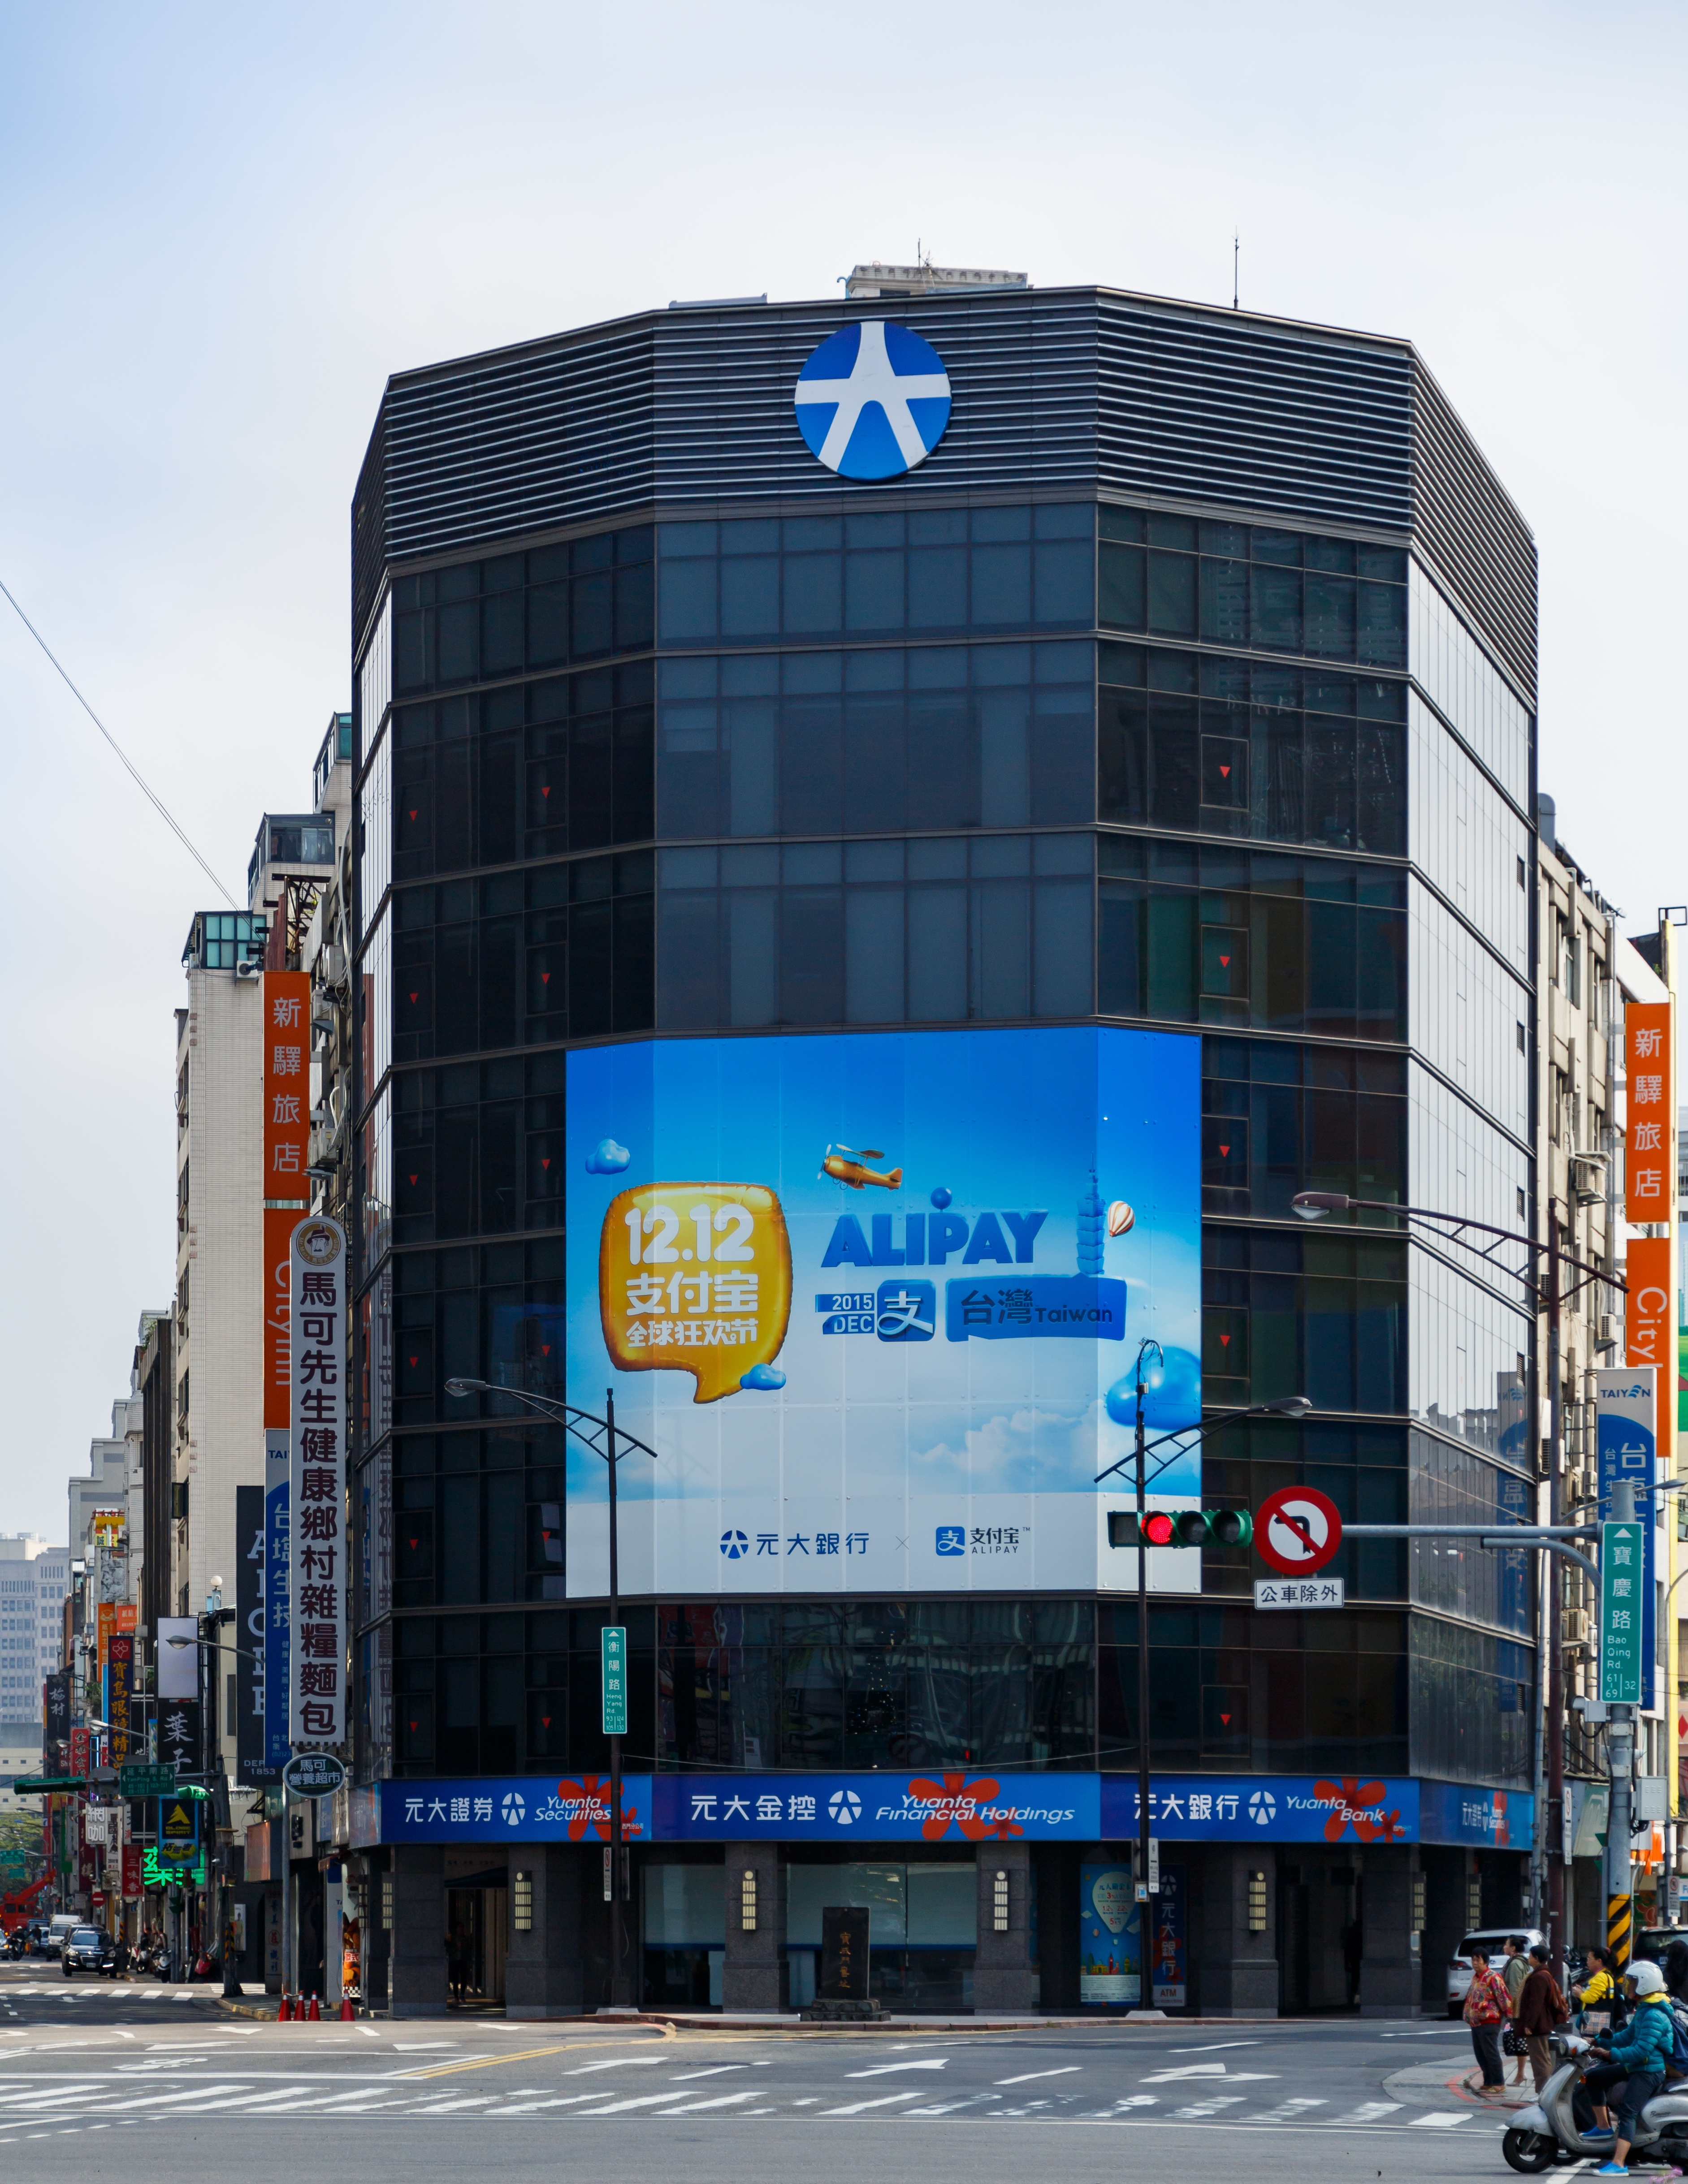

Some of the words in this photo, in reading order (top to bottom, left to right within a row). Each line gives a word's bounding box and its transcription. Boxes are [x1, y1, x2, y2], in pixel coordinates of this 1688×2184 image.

[273, 997, 301, 1172] 新驛旅店
[1635, 1029, 1662, 1197] 新驛旅店
[625, 1204, 755, 1265] 12.12
[821, 1209, 1049, 1268] ALIPAY
[626, 1269, 758, 1316] 支付宝
[832, 1295, 873, 1311] 2015
[961, 1289, 1032, 1326] 台灣
[1035, 1305, 1112, 1325] Taiwan
[626, 1320, 758, 1347] 全球狂欢节
[833, 1317, 872, 1334] DEC
[299, 1272, 338, 1736] 馬可先生健康鄉村雜糧麵包
[756, 1532, 870, 1556] 元大銀行
[970, 1527, 1019, 1545] 支付宝
[1261, 1584, 1338, 1603] 公車除外
[1612, 1546, 1632, 1629] 寶慶路
[1607, 1636, 1627, 1644] Bao
[1607, 1648, 1631, 1659] Qing
[608, 1641, 619, 1690] 衡陽路
[1607, 1661, 1623, 1669] Rd.
[1606, 1674, 1618, 1682] 61
[1625, 1681, 1636, 1690] 32
[1606, 1689, 1618, 1697] 69
[300, 1760, 326, 1772] 馬可
[289, 1772, 341, 1786] 營養超市
[406, 1797, 493, 1822] 元大證券
[547, 1796, 601, 1808] Yuanta
[691, 1795, 816, 1821] 元大金控
[902, 1795, 976, 1808] Yuanta
[1286, 1796, 1346, 1810] Yuanta
[535, 1808, 611, 1821] Securities
[876, 1807, 975, 1821] Financial
[980, 1806, 1075, 1824] Holdings
[1341, 1808, 1385, 1822] Bank
[1160, 1988, 1177, 1997] ATM
